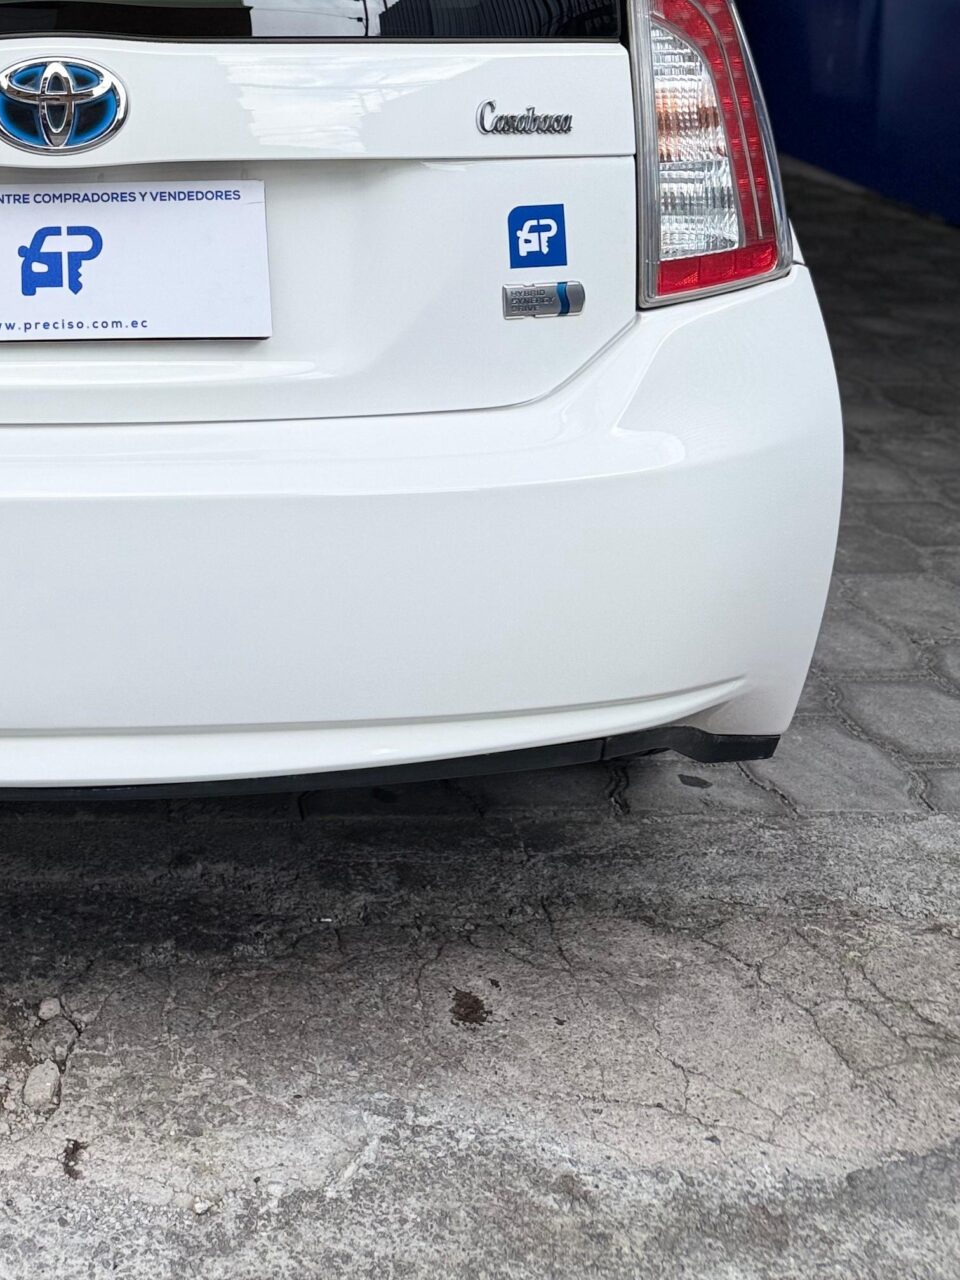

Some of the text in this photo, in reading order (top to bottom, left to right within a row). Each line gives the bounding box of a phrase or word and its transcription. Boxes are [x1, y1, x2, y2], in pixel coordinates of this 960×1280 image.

[33, 191, 137, 204] COMPRADORES
[138, 191, 148, 202] Y
[150, 190, 241, 202] VENDEDORES
